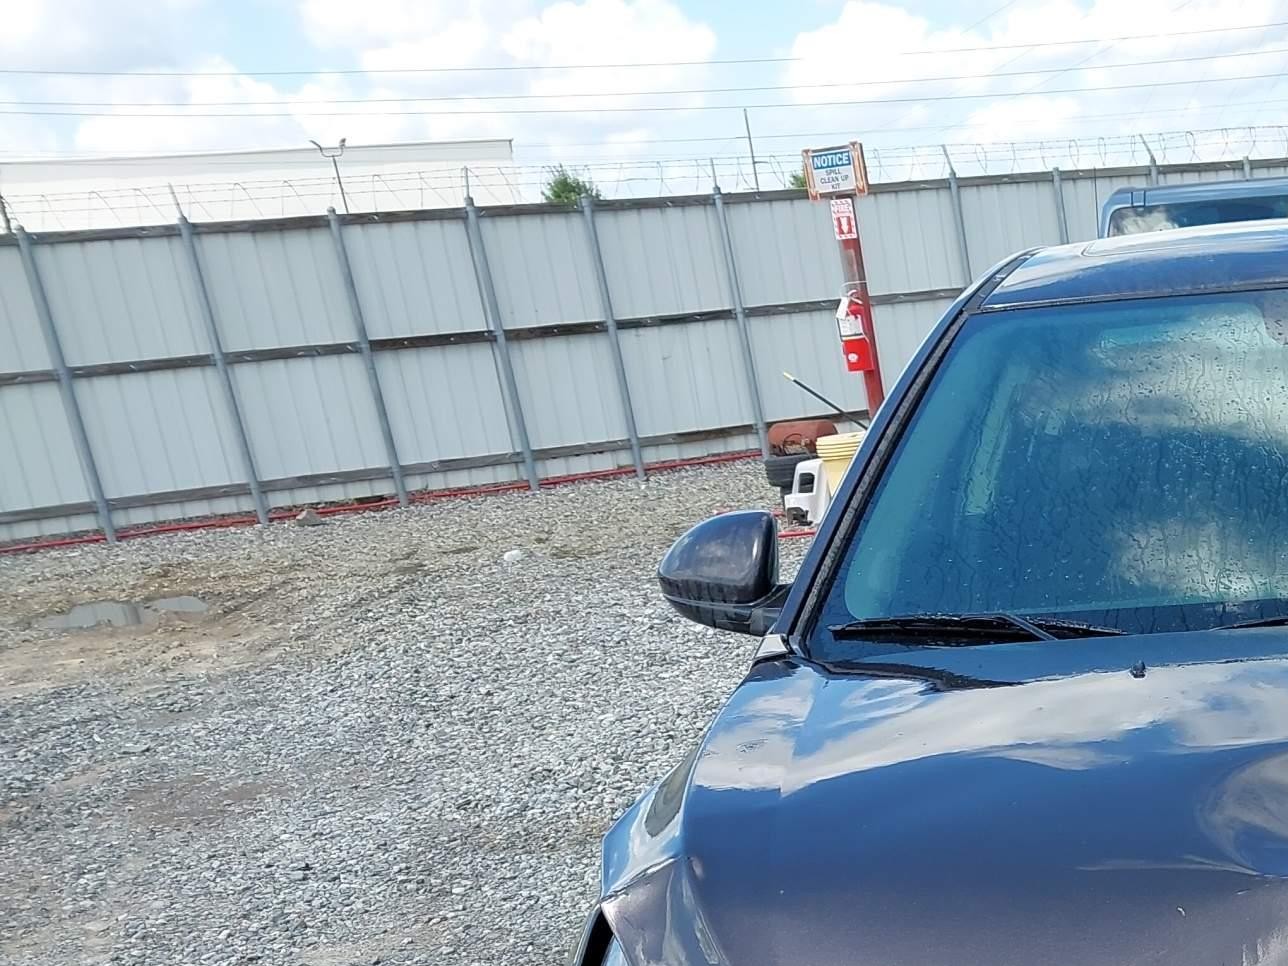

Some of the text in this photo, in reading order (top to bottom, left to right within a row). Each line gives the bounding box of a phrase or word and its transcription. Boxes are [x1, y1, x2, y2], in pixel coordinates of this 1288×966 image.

[814, 153, 849, 168] NOTICE
[825, 168, 841, 176] SPILL
[820, 176, 839, 184] CLEAN
